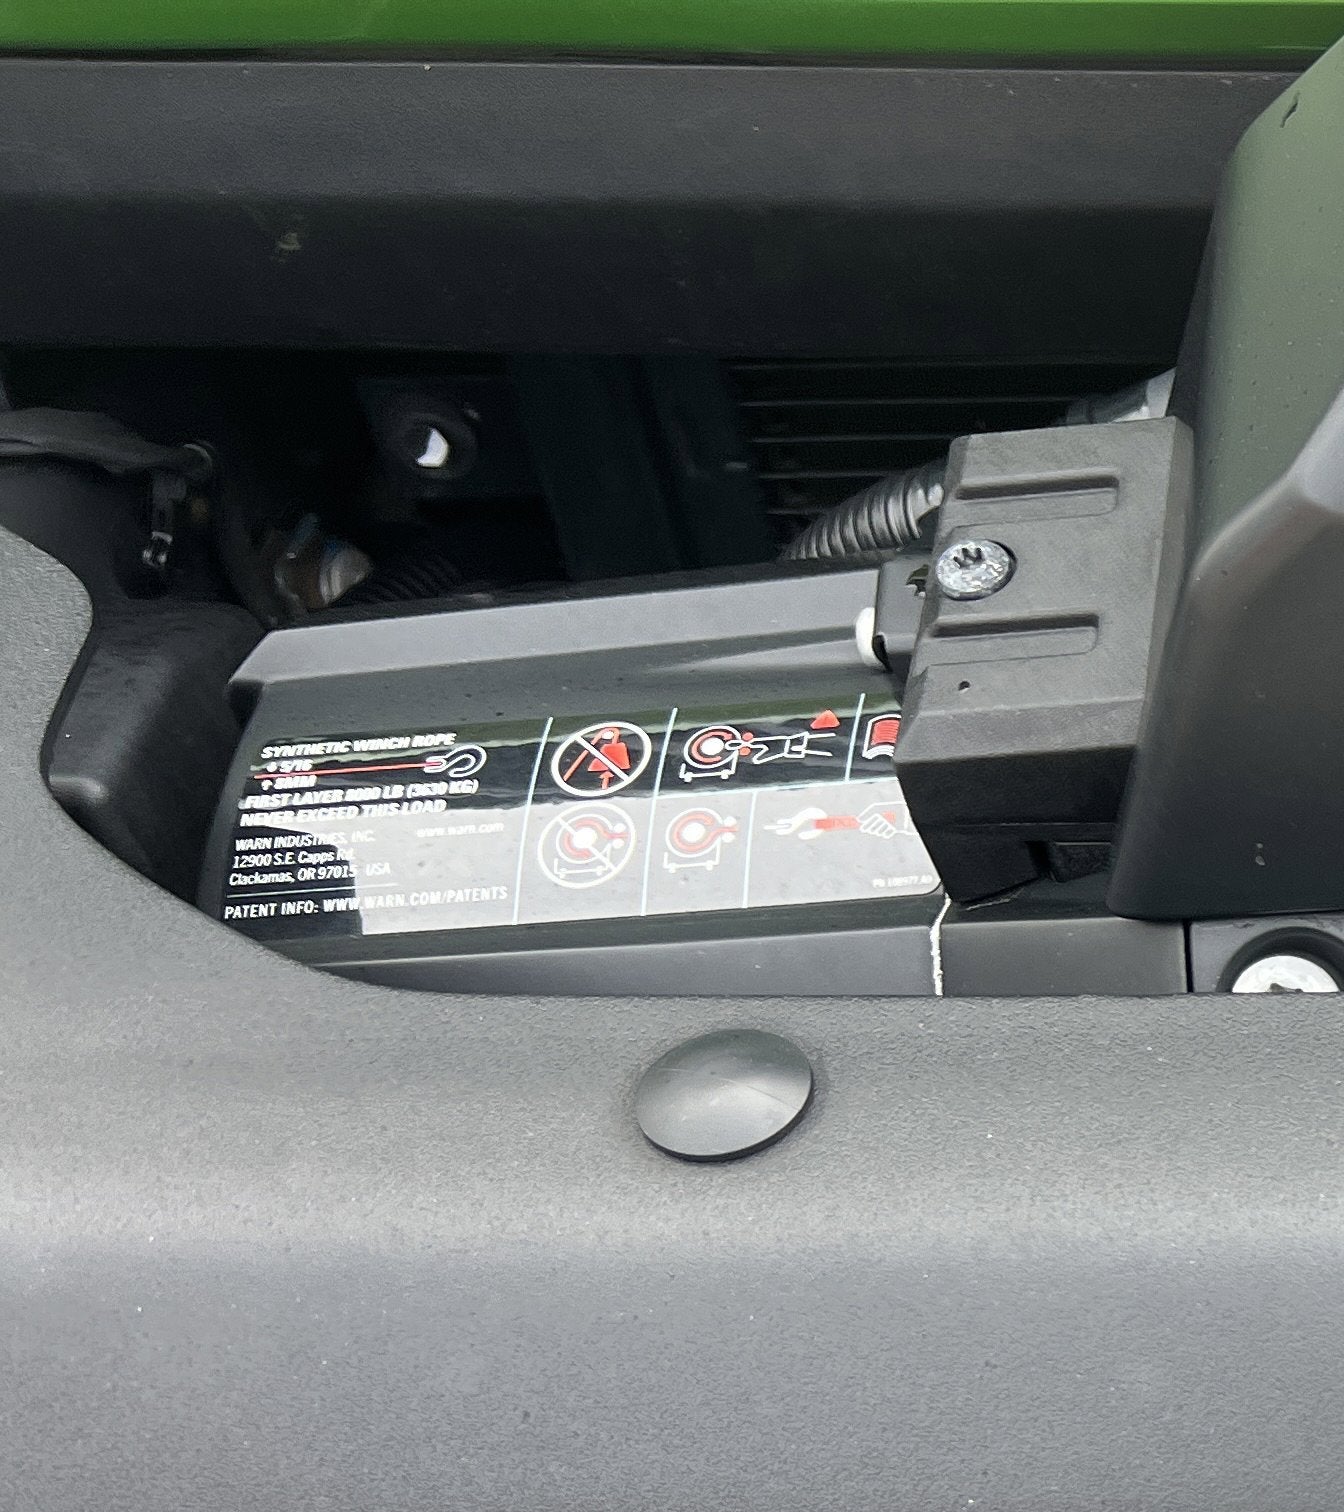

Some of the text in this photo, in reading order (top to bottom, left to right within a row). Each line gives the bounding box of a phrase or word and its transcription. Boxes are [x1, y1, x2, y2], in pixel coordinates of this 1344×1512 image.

[261, 733, 457, 759] SYNTHETIC WINCH ROPE
[244, 793, 293, 810] FIRST
[291, 789, 345, 806] LAYER
[240, 798, 448, 828] NEVER EXCEED THIS LOAD
[235, 837, 273, 852] WARN
[232, 853, 273, 869] 12900
[296, 850, 336, 865] Capps
[297, 867, 317, 881] OR
[317, 865, 359, 881] 97015
[365, 862, 392, 877] USA
[224, 886, 509, 920] PATENT INFO: WWW.WARN.COM/PATENTS
